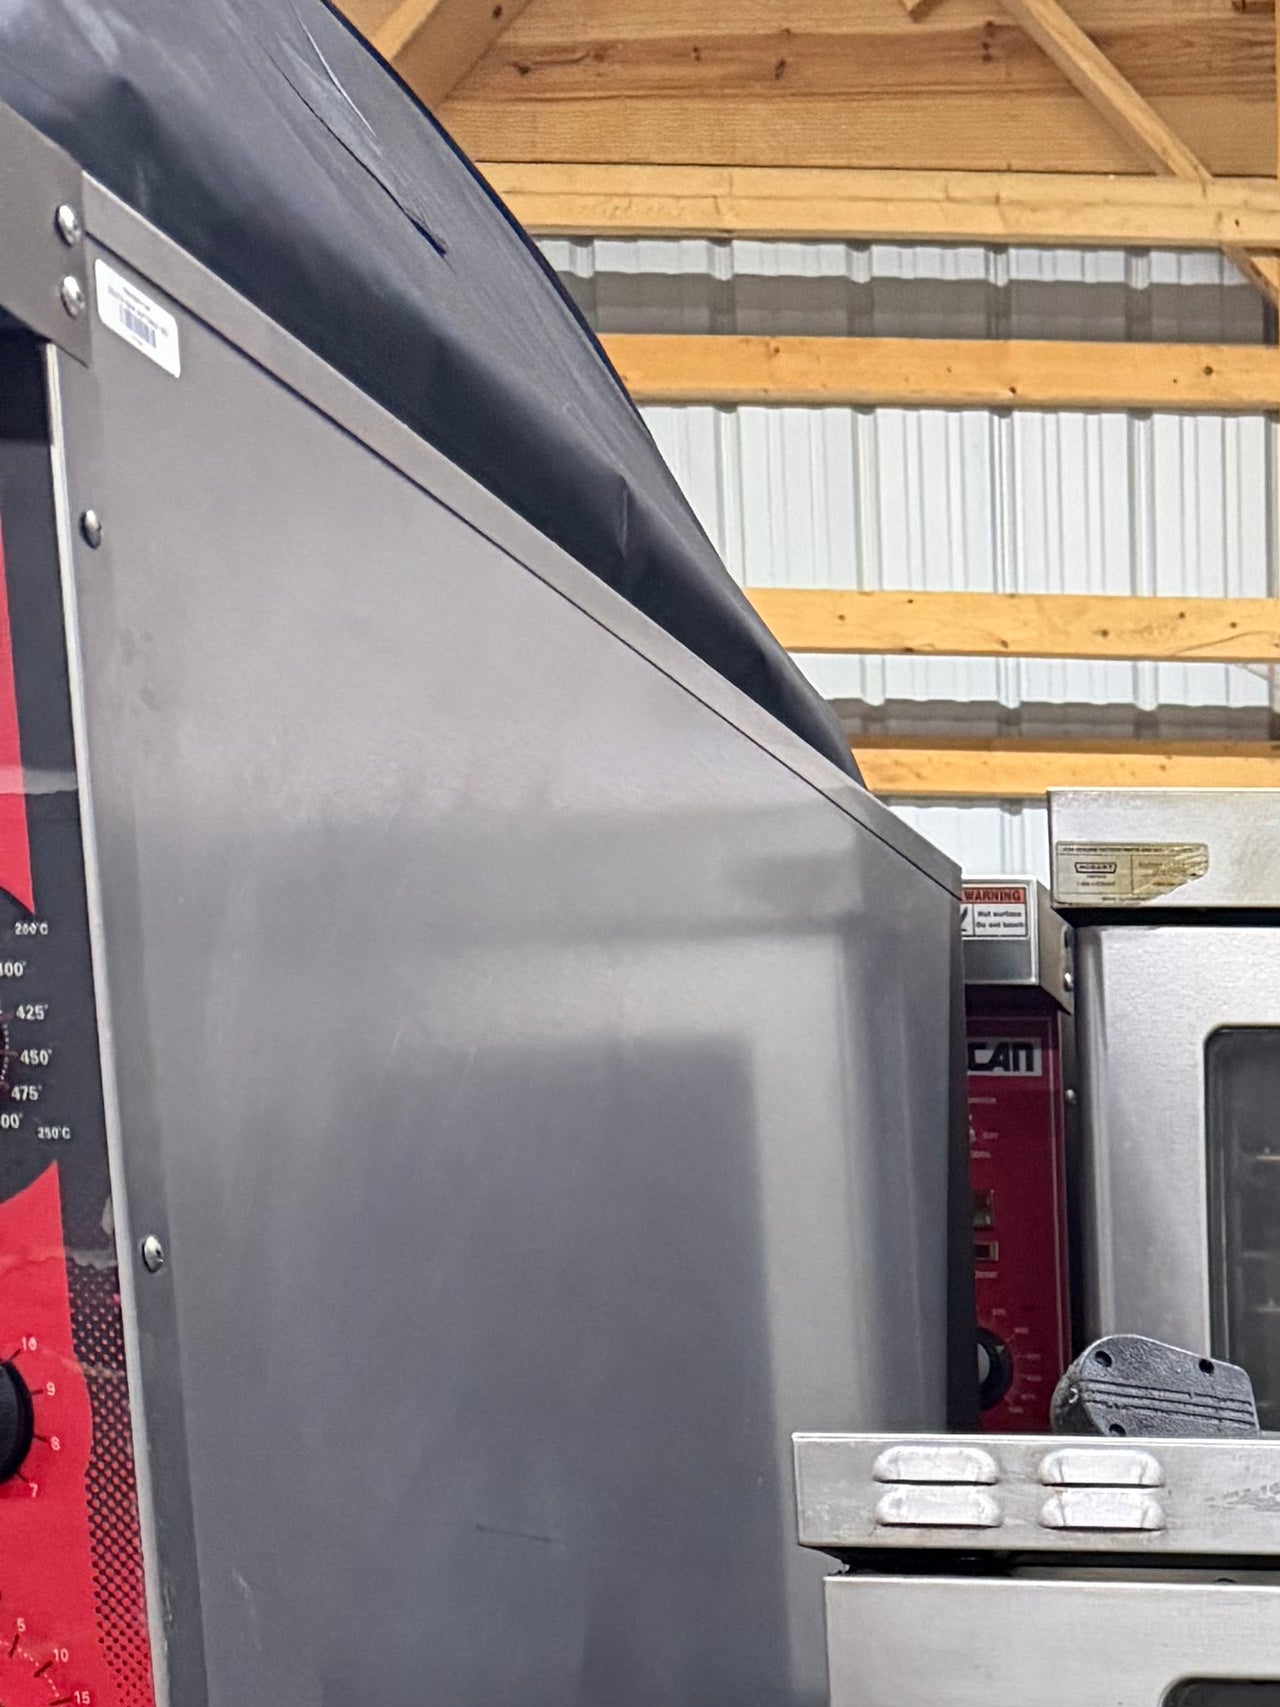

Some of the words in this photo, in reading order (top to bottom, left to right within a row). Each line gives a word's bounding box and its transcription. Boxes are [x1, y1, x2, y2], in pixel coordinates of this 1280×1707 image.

[964, 890, 1020, 901] WARNING
[17, 1618, 26, 1632] 5
[53, 1648, 69, 1662] 10
[74, 1691, 90, 1704] 15
